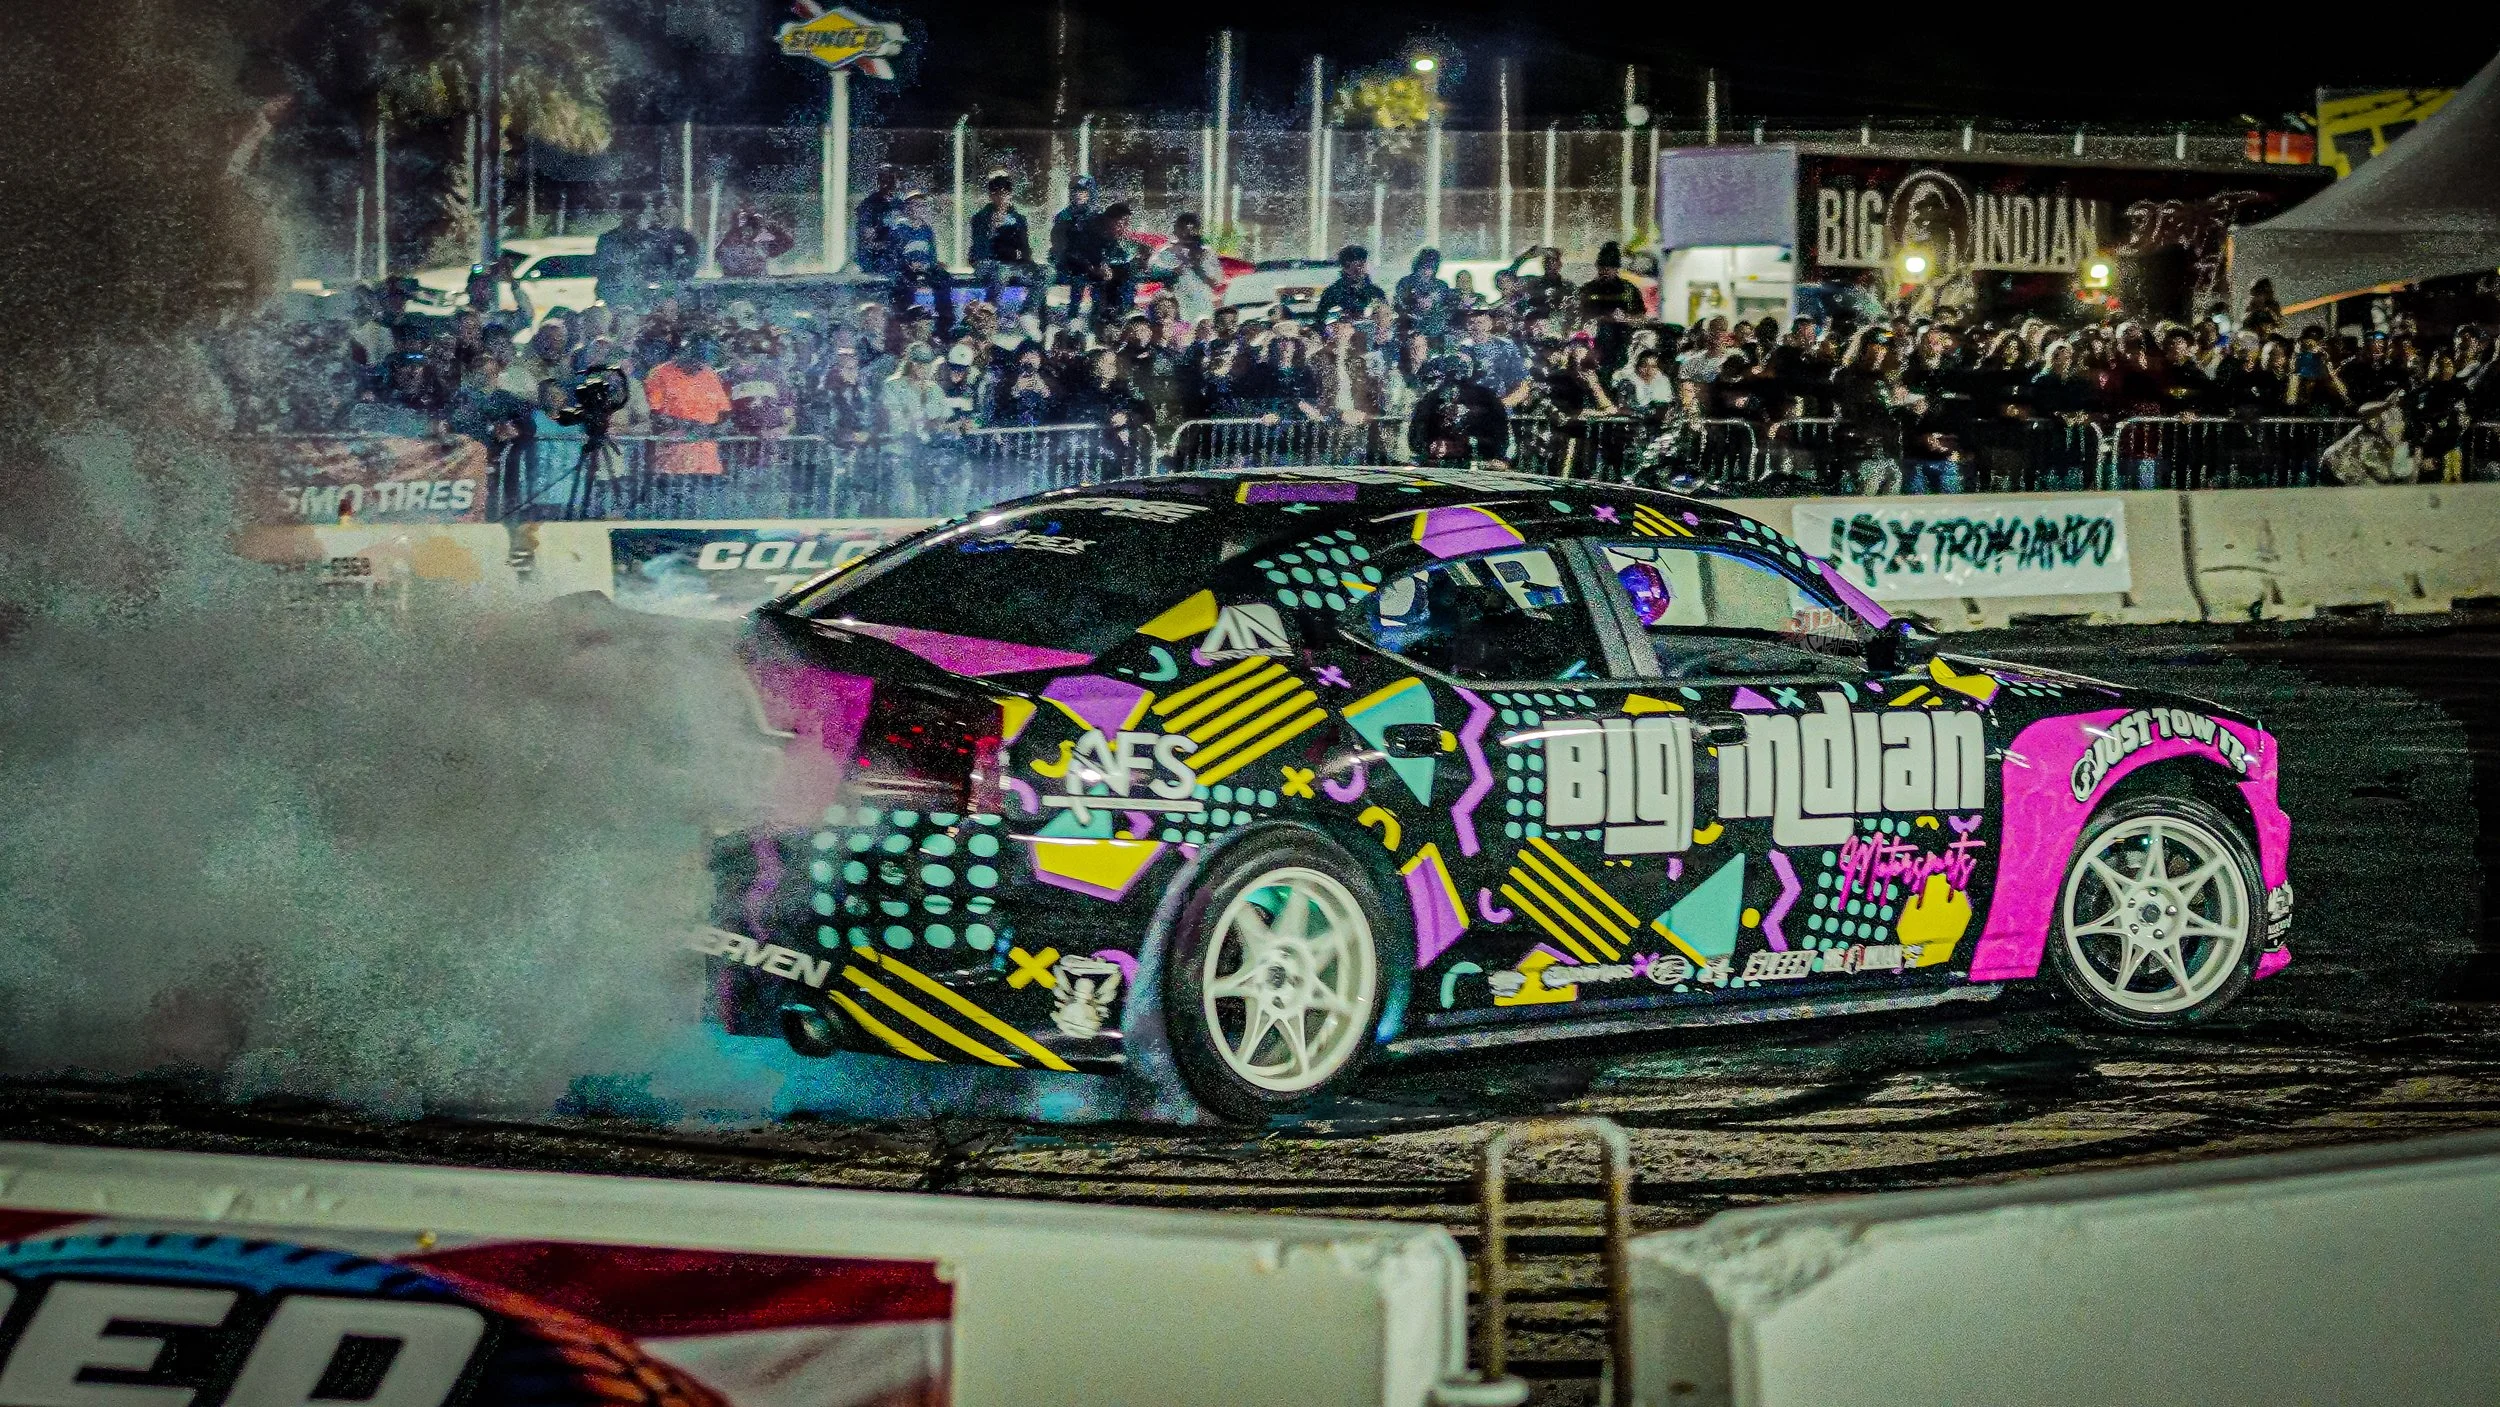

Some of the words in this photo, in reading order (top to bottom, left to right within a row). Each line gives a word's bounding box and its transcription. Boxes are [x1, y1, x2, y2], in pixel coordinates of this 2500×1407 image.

[1817, 189, 1884, 263] BIG
[1974, 188, 2098, 271] INDIAN
[374, 479, 476, 512] TIRES
[2092, 710, 2153, 782] JUST
[2151, 707, 2217, 745] TOW
[0, 1278, 486, 1407] ED
